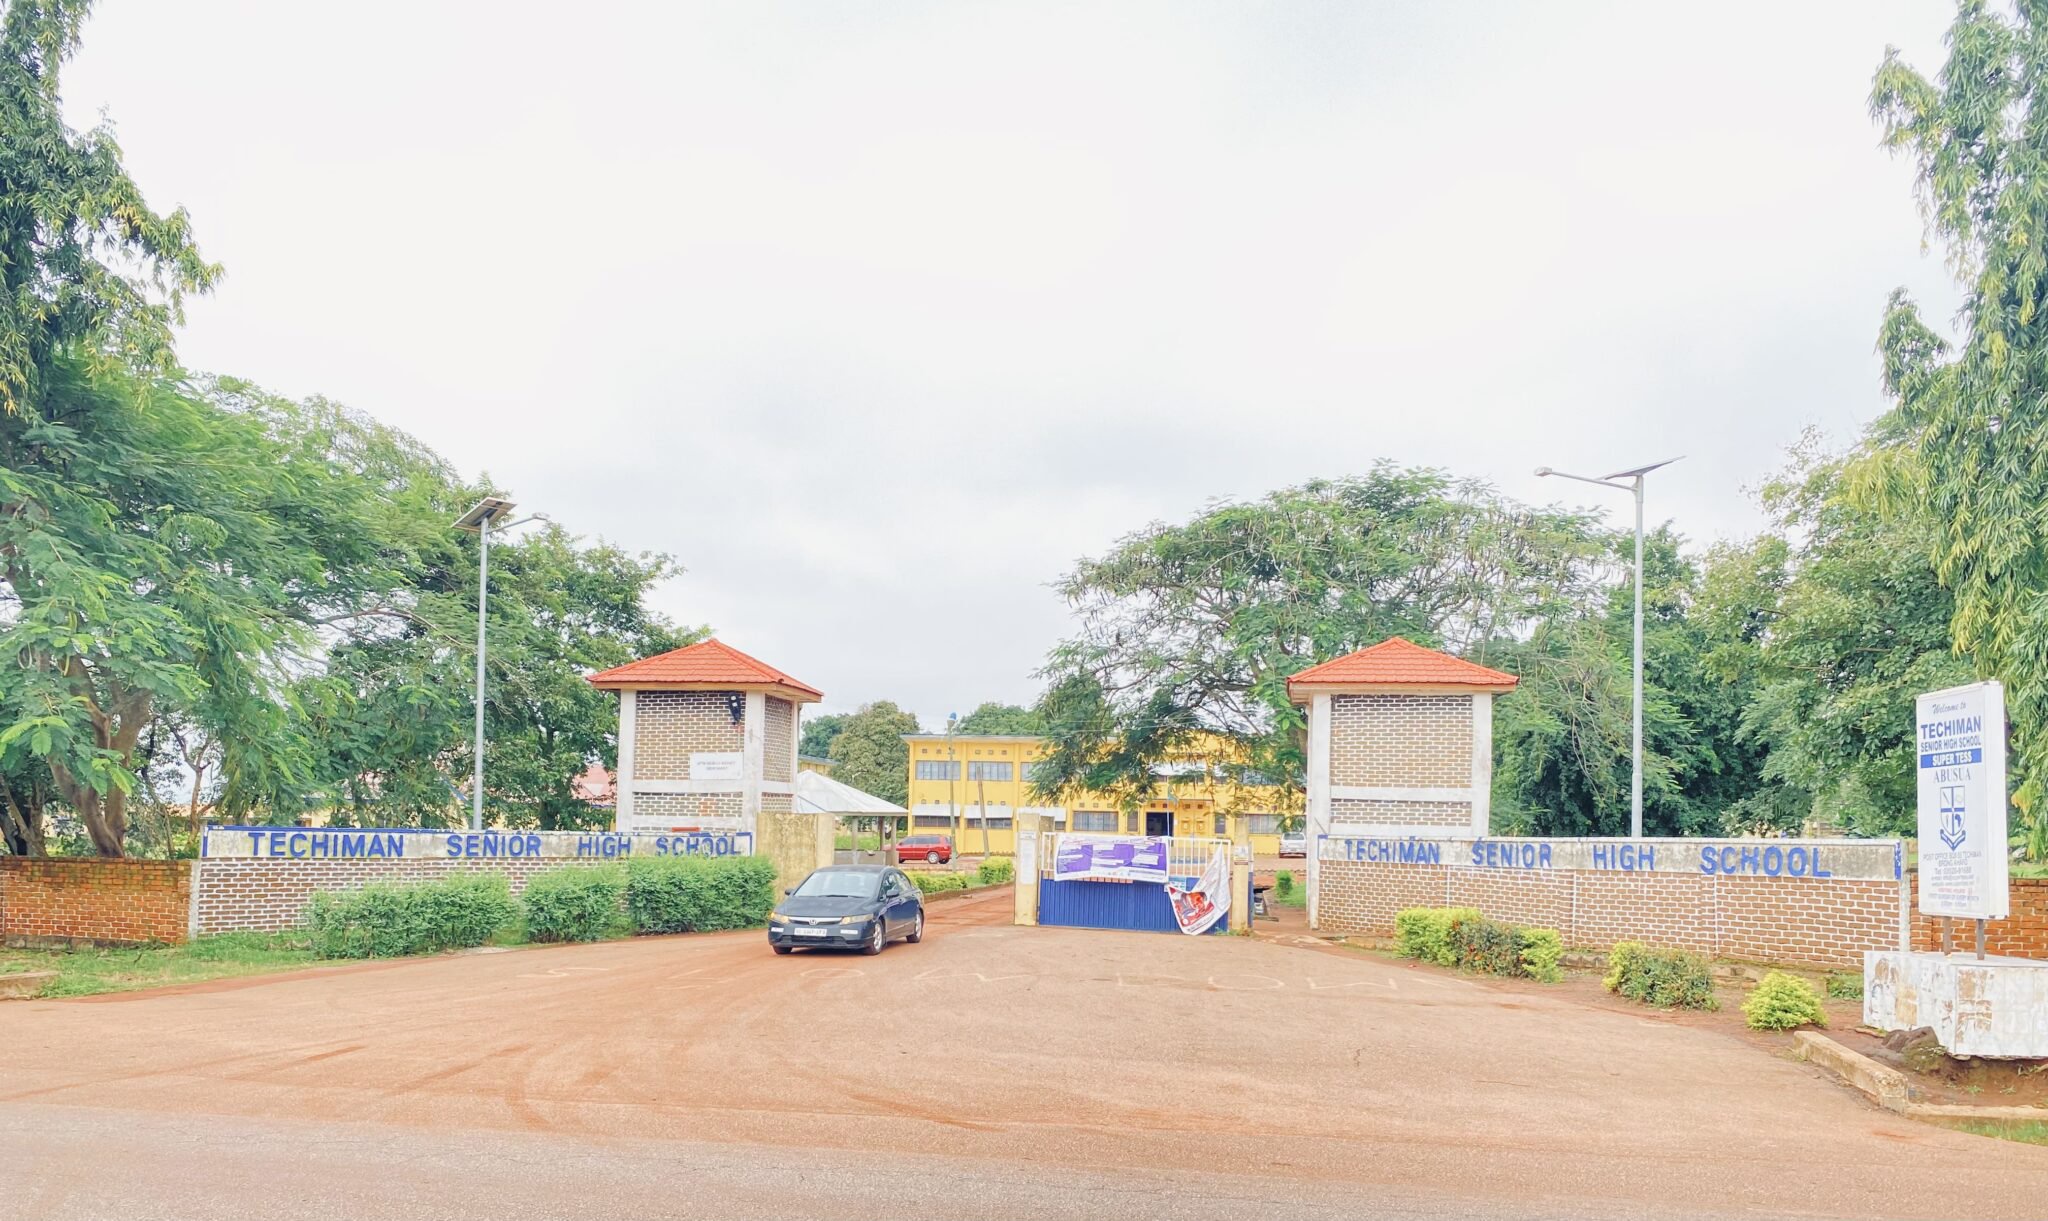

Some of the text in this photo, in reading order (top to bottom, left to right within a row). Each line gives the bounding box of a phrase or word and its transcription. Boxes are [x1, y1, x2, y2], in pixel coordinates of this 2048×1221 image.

[1932, 703, 1959, 714] Welcome
[1921, 716, 1981, 739] TECHIMAN
[1921, 736, 1981, 752] SENIOR HIGH SCHOOL
[1932, 750, 1972, 766] SUPER TESS
[1934, 767, 1971, 783] ABUSUA
[248, 832, 742, 858] TECHIMAN SENIOR HIGH SCHOOL
[1345, 839, 1831, 877] TECHIMAN SENIOR HIGH SCHOOL
